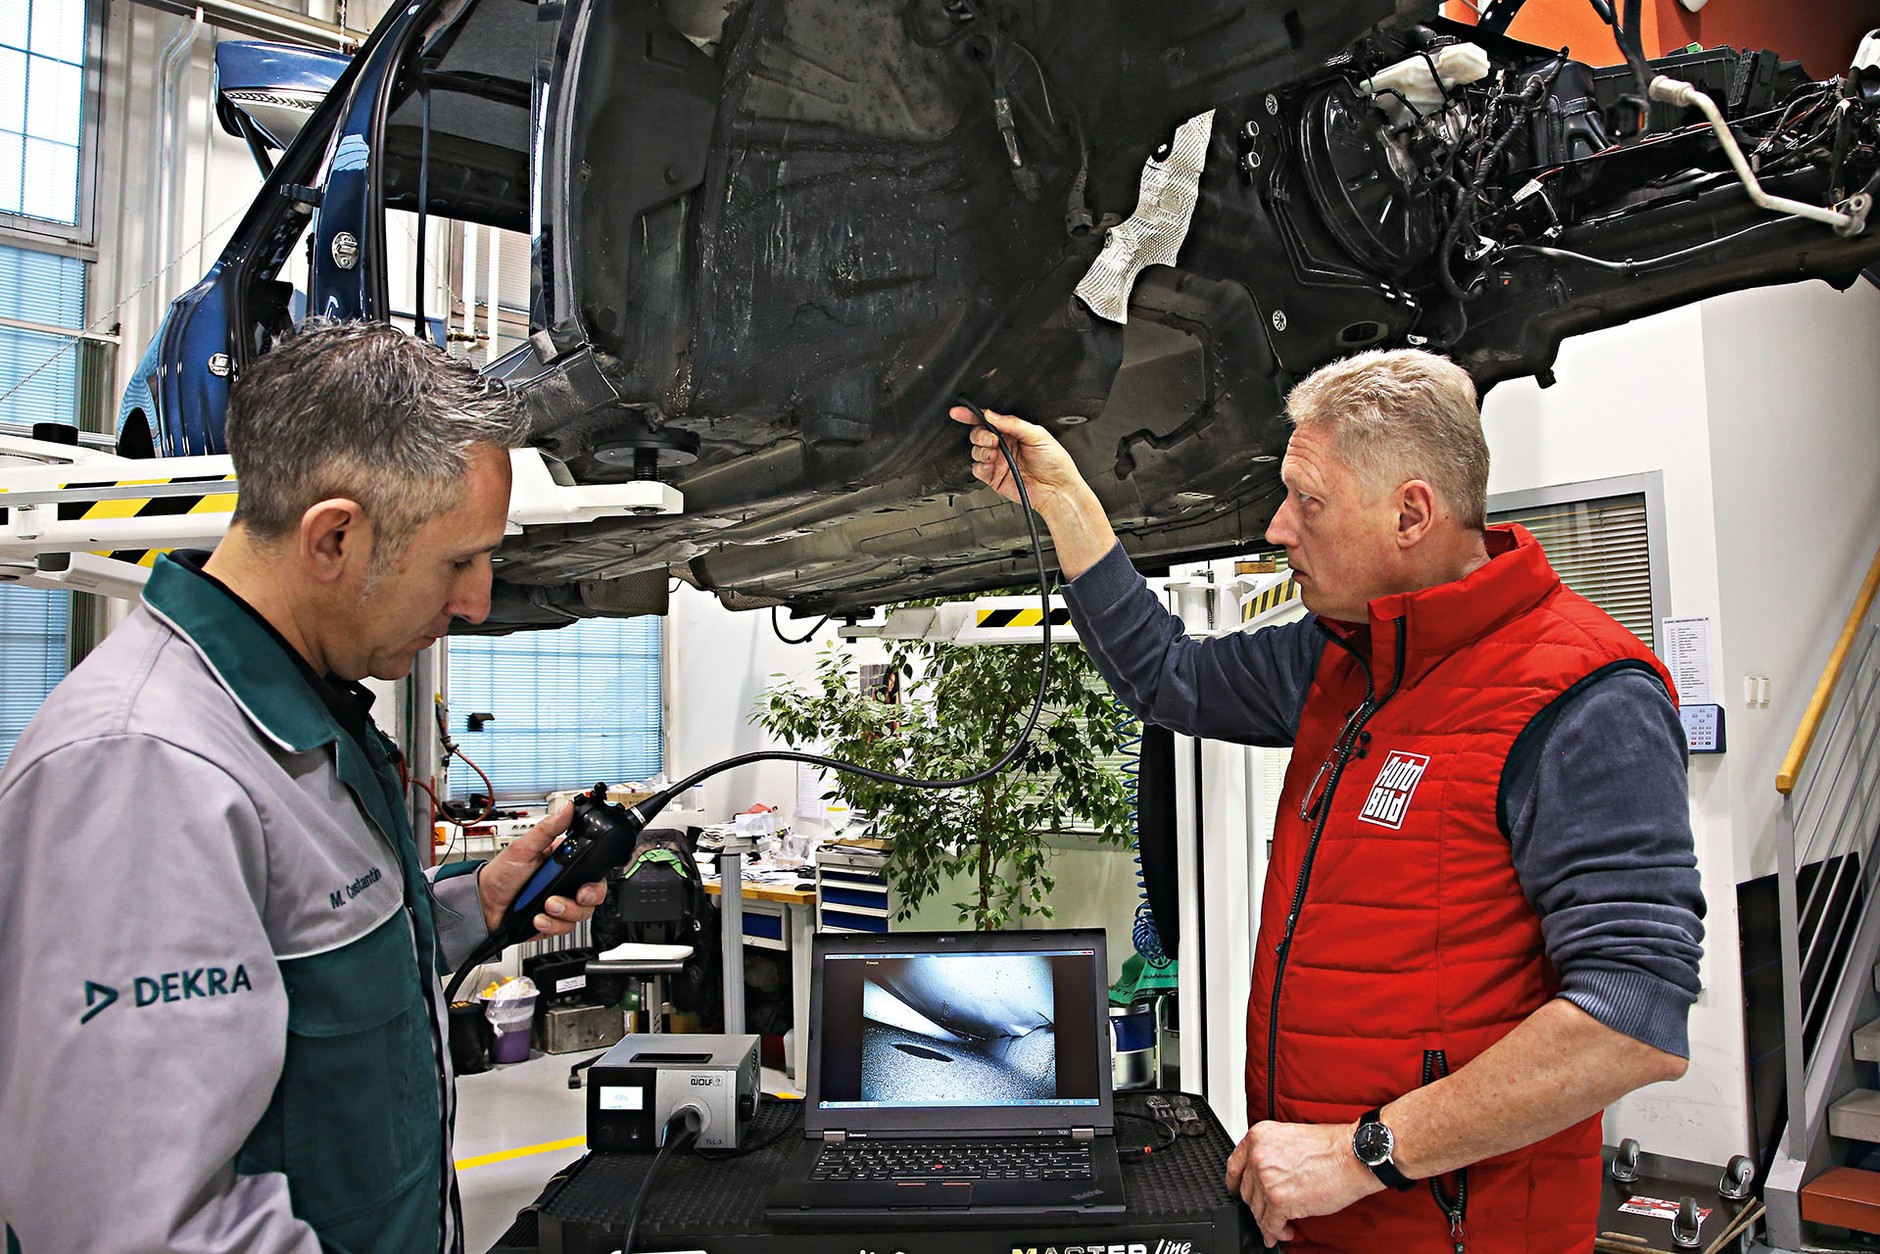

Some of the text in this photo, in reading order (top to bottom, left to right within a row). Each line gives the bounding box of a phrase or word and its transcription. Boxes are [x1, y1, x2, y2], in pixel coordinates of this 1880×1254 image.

[329, 890, 346, 909] M.
[133, 964, 252, 1008] DEKRA
[690, 1078, 713, 1086] WOLF
